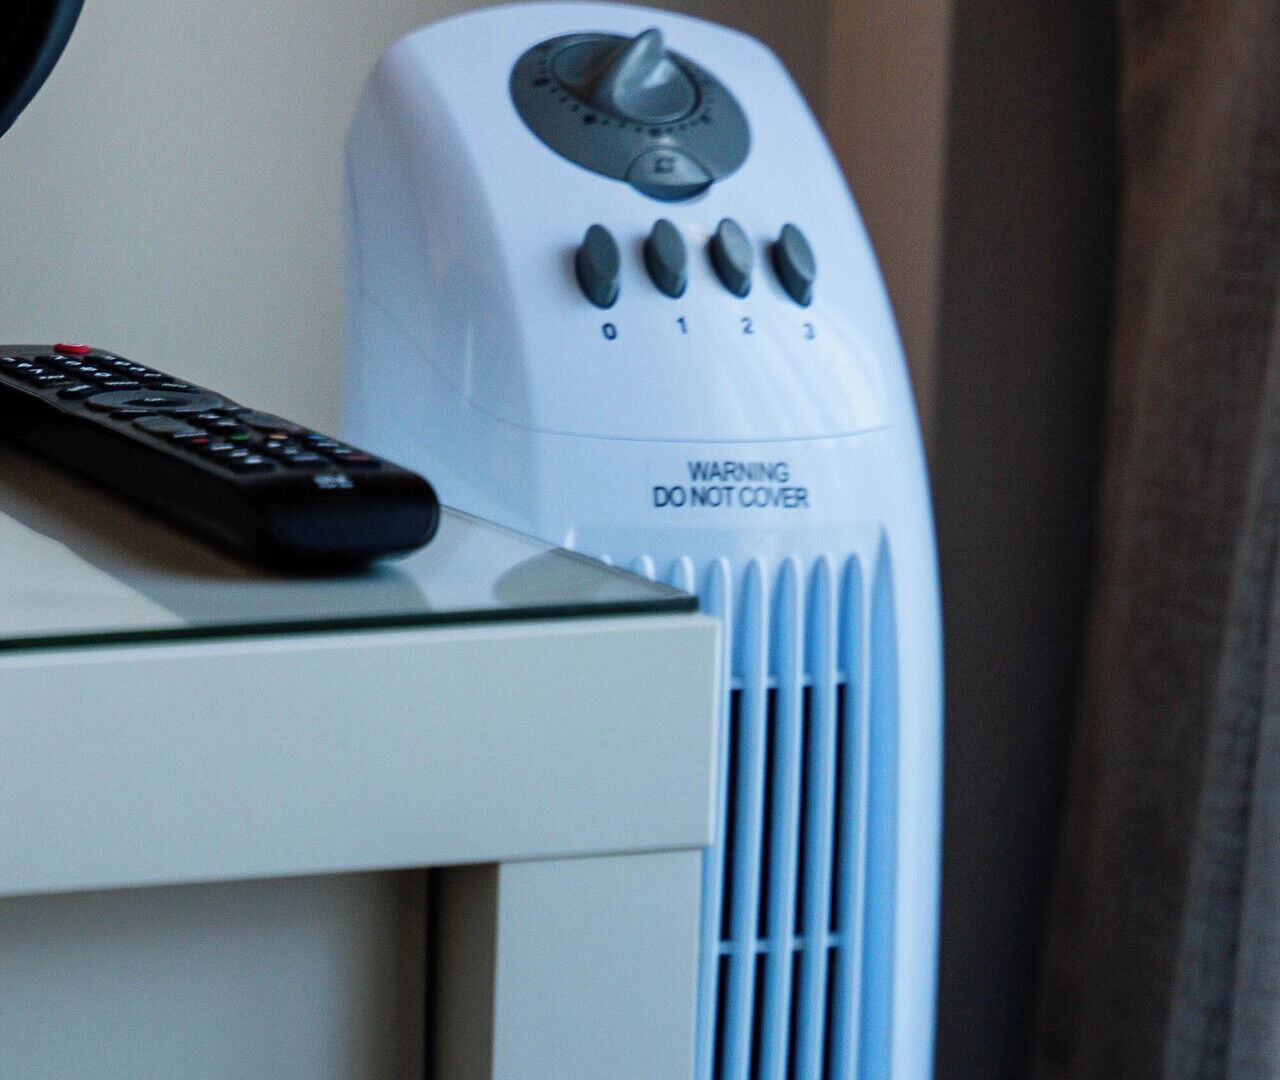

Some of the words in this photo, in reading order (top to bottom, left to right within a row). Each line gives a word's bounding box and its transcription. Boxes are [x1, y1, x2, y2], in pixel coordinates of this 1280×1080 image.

[602, 322, 618, 341] 0
[676, 316, 688, 335] 1
[741, 316, 754, 335] 2
[803, 322, 816, 341] 3
[687, 460, 790, 483] WARNING
[653, 486, 687, 508] DO
[691, 486, 736, 508] NOT
[739, 486, 810, 508] COVER
